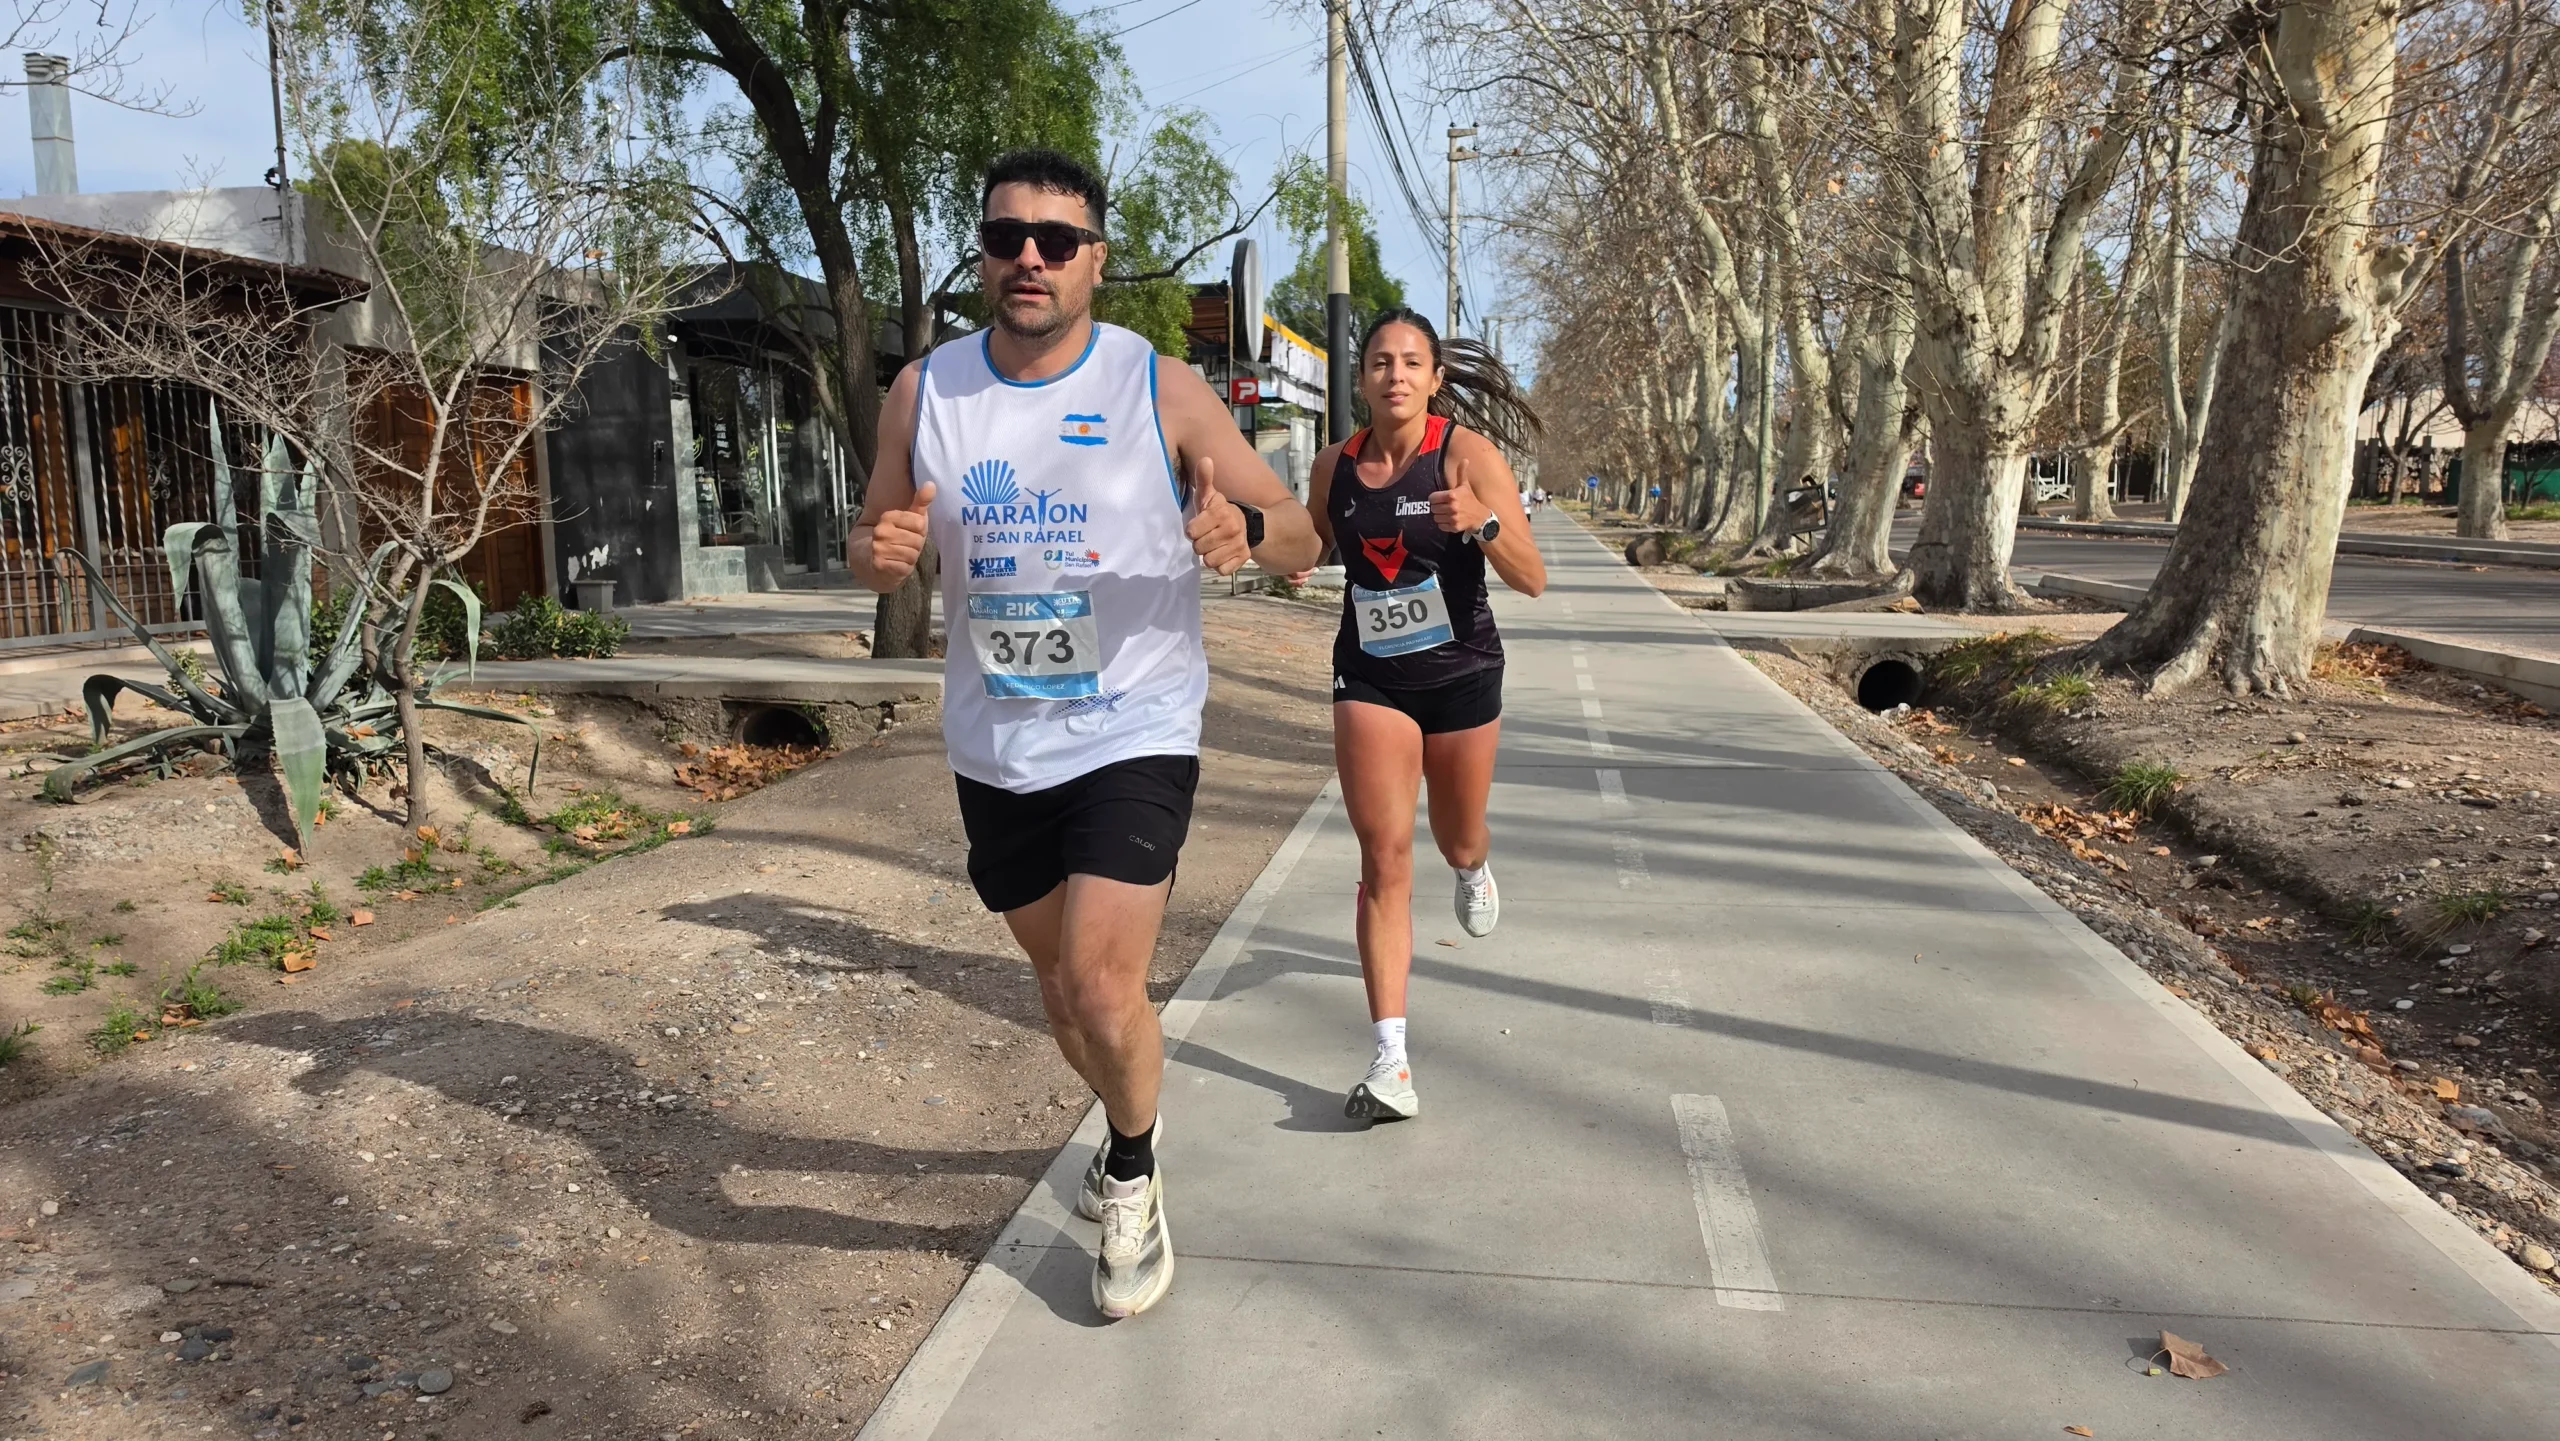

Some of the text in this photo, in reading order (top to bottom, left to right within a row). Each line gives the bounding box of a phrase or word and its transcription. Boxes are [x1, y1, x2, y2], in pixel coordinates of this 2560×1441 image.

[1238, 382, 1257, 400] P
[1395, 501, 1431, 516] LINCES
[973, 530, 1086, 544] DE SAN RAFAEL
[985, 556, 1017, 569] UTN
[1005, 602, 1041, 617] 21K
[1369, 599, 1428, 633] 350
[990, 629, 1075, 666] 373
